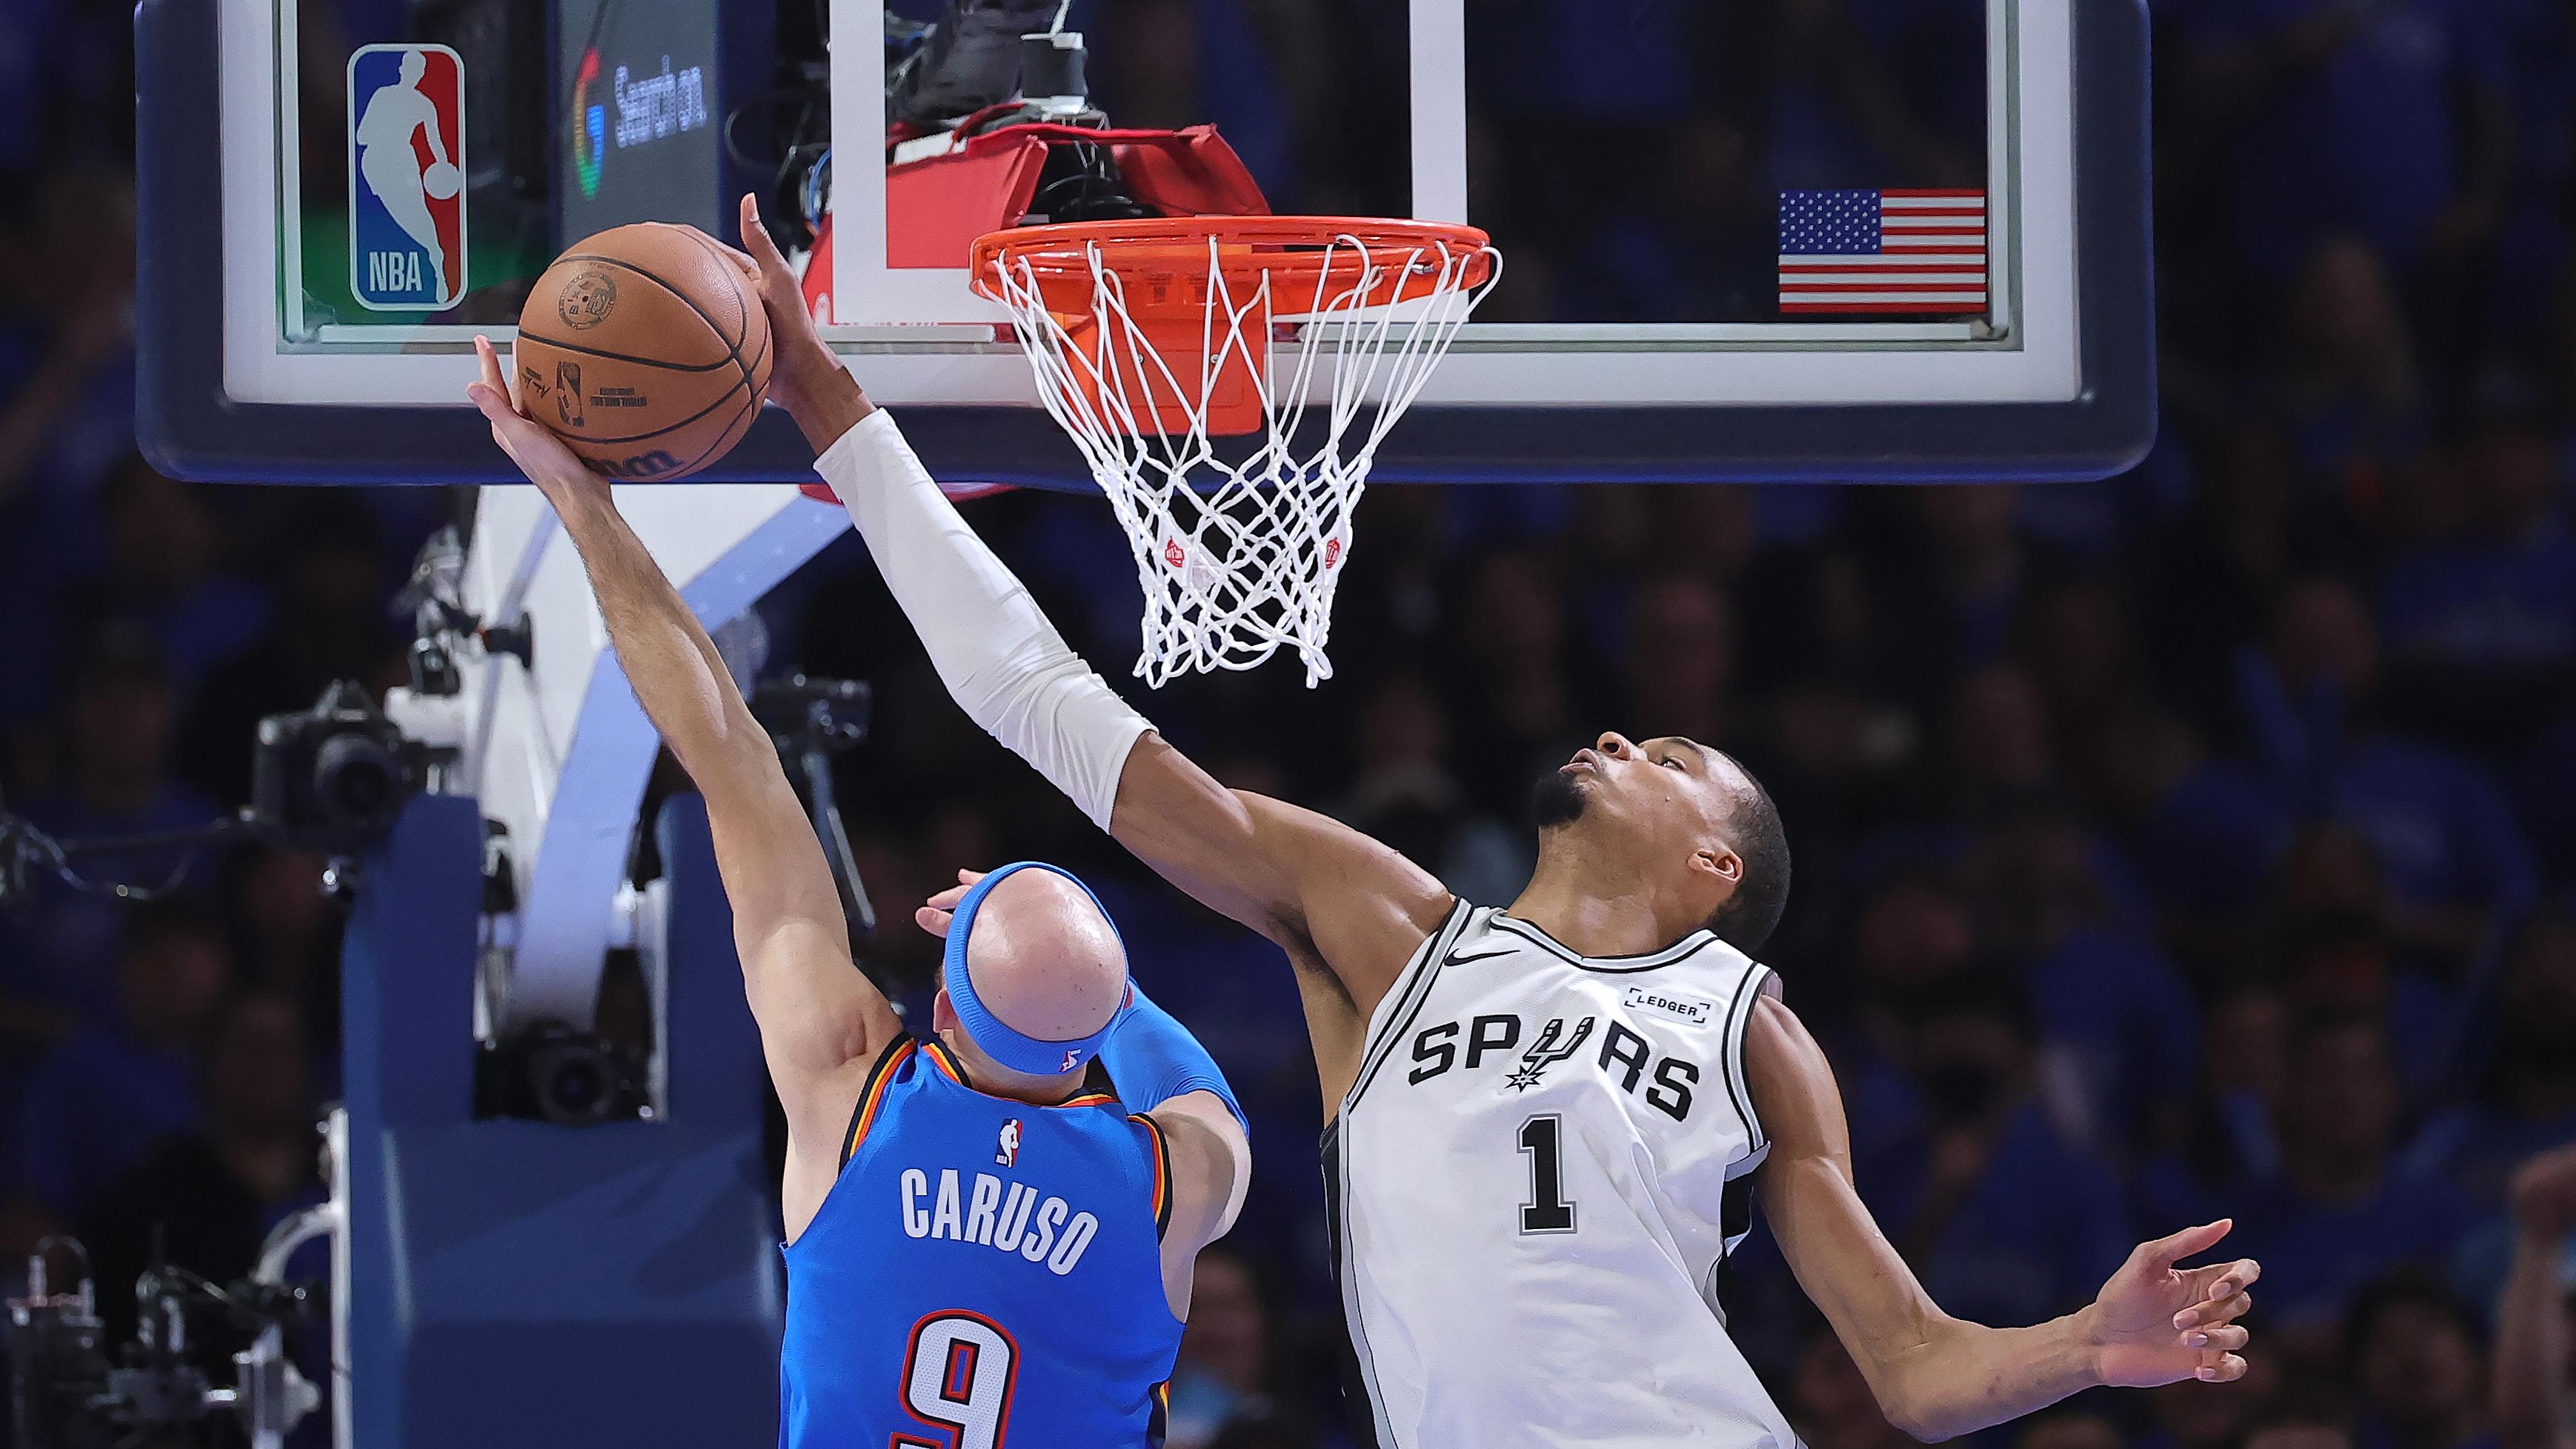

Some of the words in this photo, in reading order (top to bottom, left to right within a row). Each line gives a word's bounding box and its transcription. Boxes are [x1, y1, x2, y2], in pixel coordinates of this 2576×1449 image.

[369, 251, 422, 292] NBA
[1637, 995, 1698, 1016] LEDGER
[1408, 1014, 1700, 1122] SPURS
[900, 1168, 1099, 1276] CARUSO
[1516, 1113, 1577, 1236] 1
[889, 1308, 1021, 1449] 9
